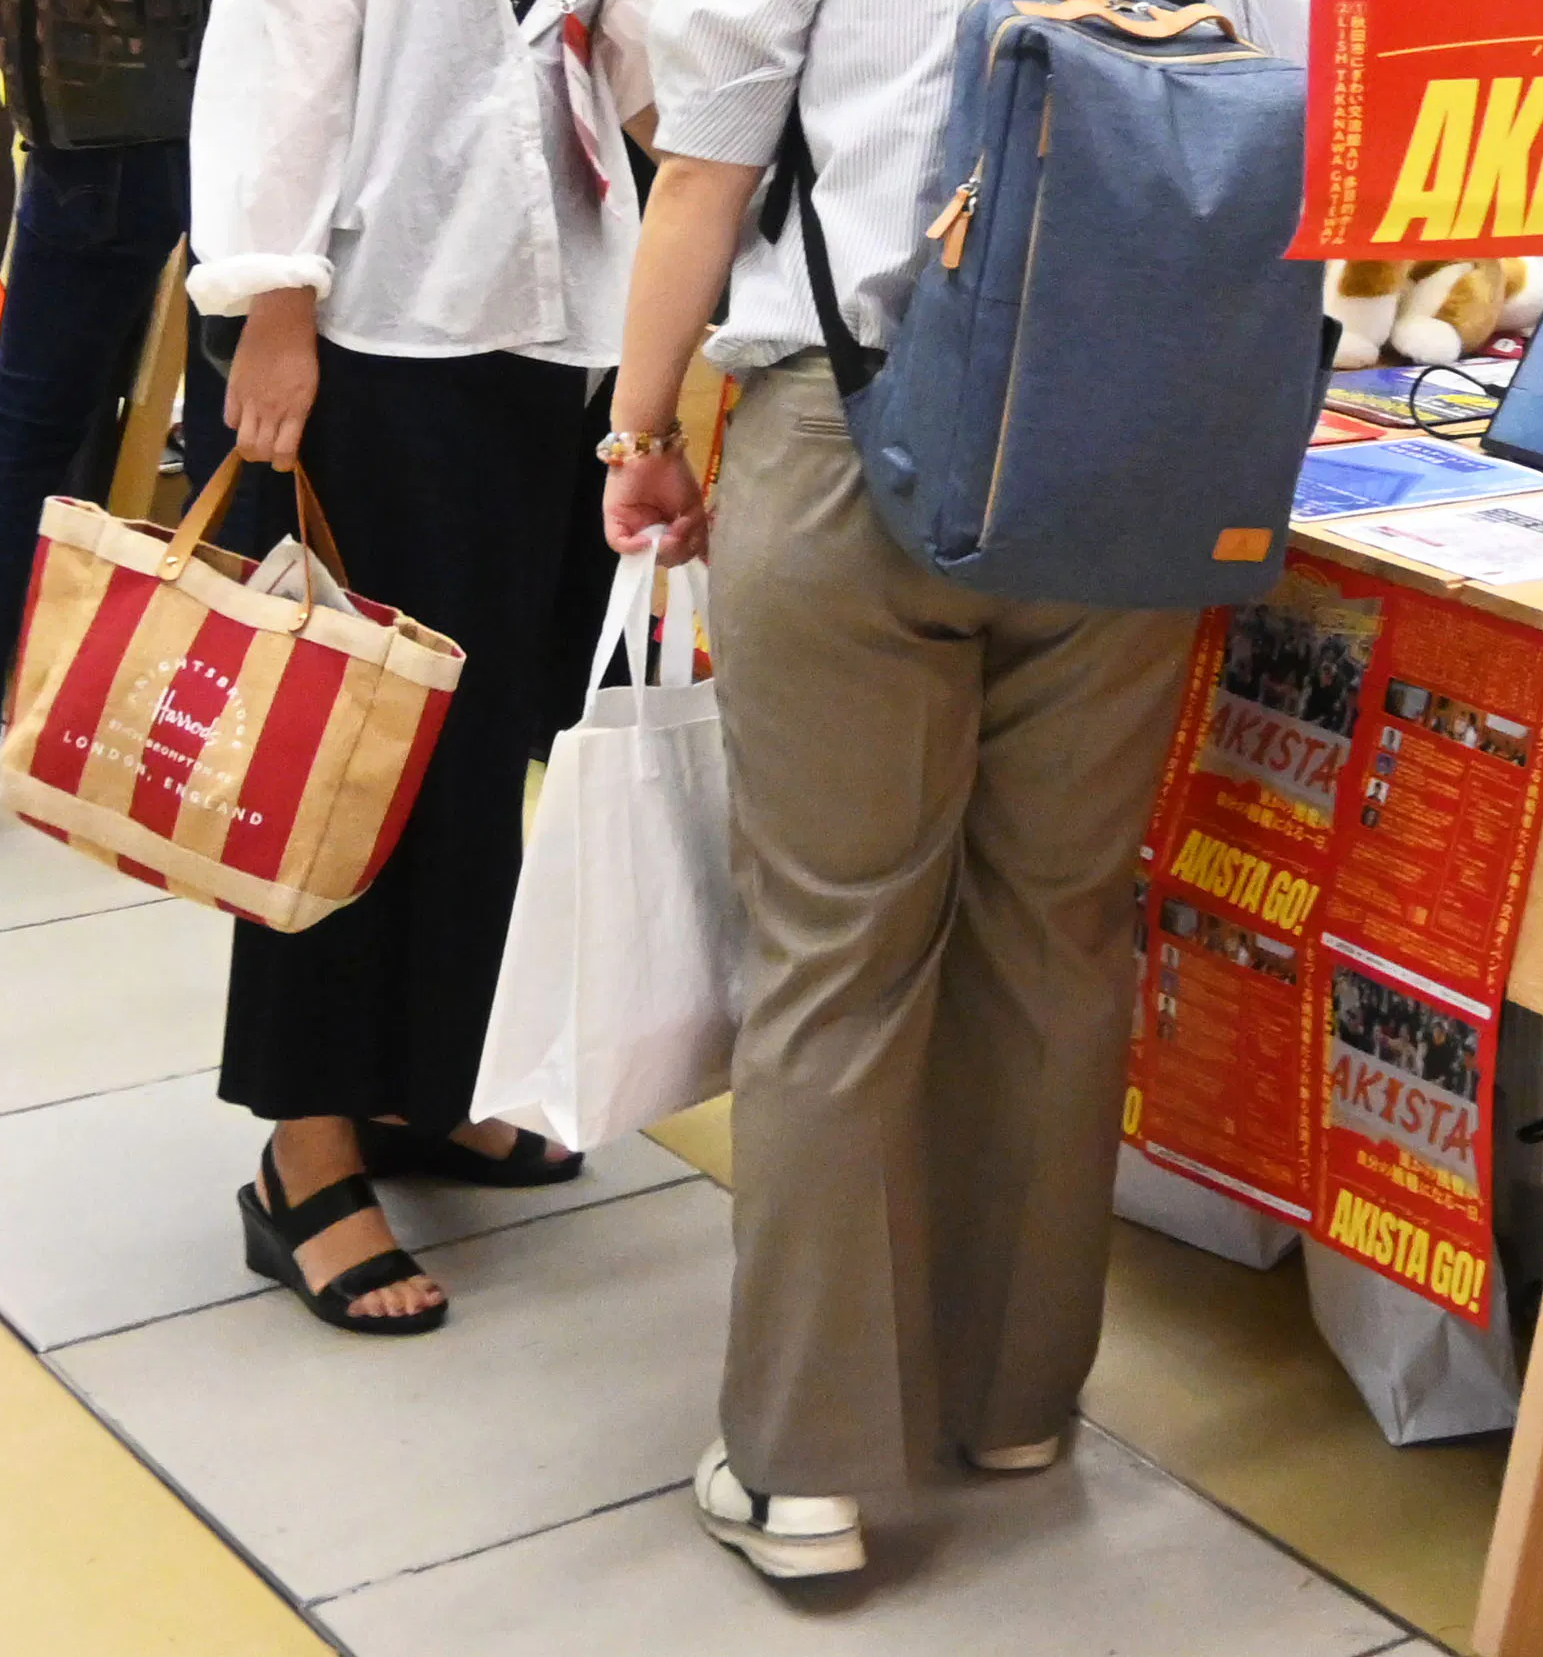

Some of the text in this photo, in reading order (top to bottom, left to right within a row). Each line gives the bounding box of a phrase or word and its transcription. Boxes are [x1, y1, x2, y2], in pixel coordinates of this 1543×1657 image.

[1330, 69, 1348, 166] TAKANAWA
[146, 738, 213, 776] BROMPTON
[151, 686, 222, 747] Harrods
[1211, 701, 1344, 795] AKISTA
[62, 731, 264, 826] LONDON, ENGLAND
[1170, 829, 1272, 914] AKISTA
[1261, 869, 1321, 937] GO!
[1330, 1053, 1475, 1163] AKISTA
[1328, 1187, 1487, 1314] AKISTA GO!
